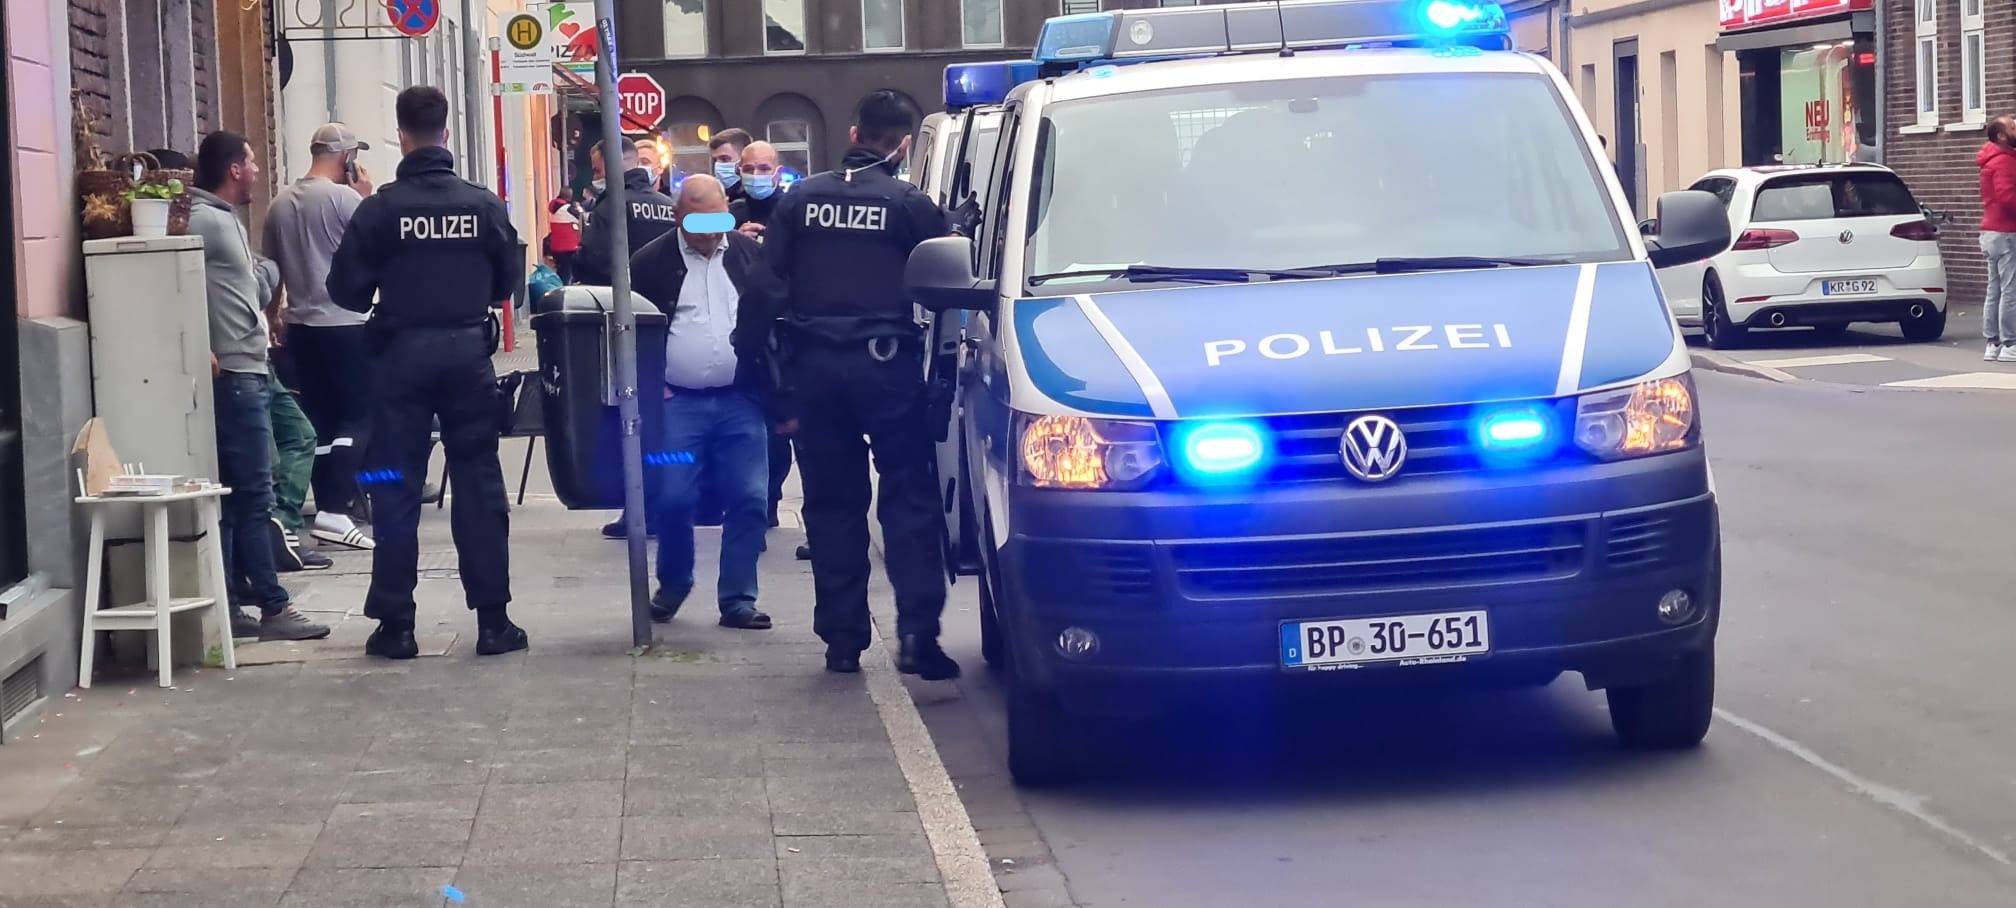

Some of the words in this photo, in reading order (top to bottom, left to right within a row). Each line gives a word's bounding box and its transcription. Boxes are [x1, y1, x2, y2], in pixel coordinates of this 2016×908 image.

[516, 22, 532, 42] H
[1805, 99, 1830, 127] NEU
[631, 202, 676, 222] POLIZE
[805, 203, 888, 231] POLIZEI
[400, 215, 479, 240] POLIZEI
[1830, 281, 1845, 293] KR
[1851, 280, 1860, 292] G
[1861, 280, 1876, 291] 92
[1203, 323, 1513, 367] POLIZEI
[1288, 647, 1297, 658] D
[1307, 625, 1346, 659] BP
[1368, 615, 1482, 654] 30-651
